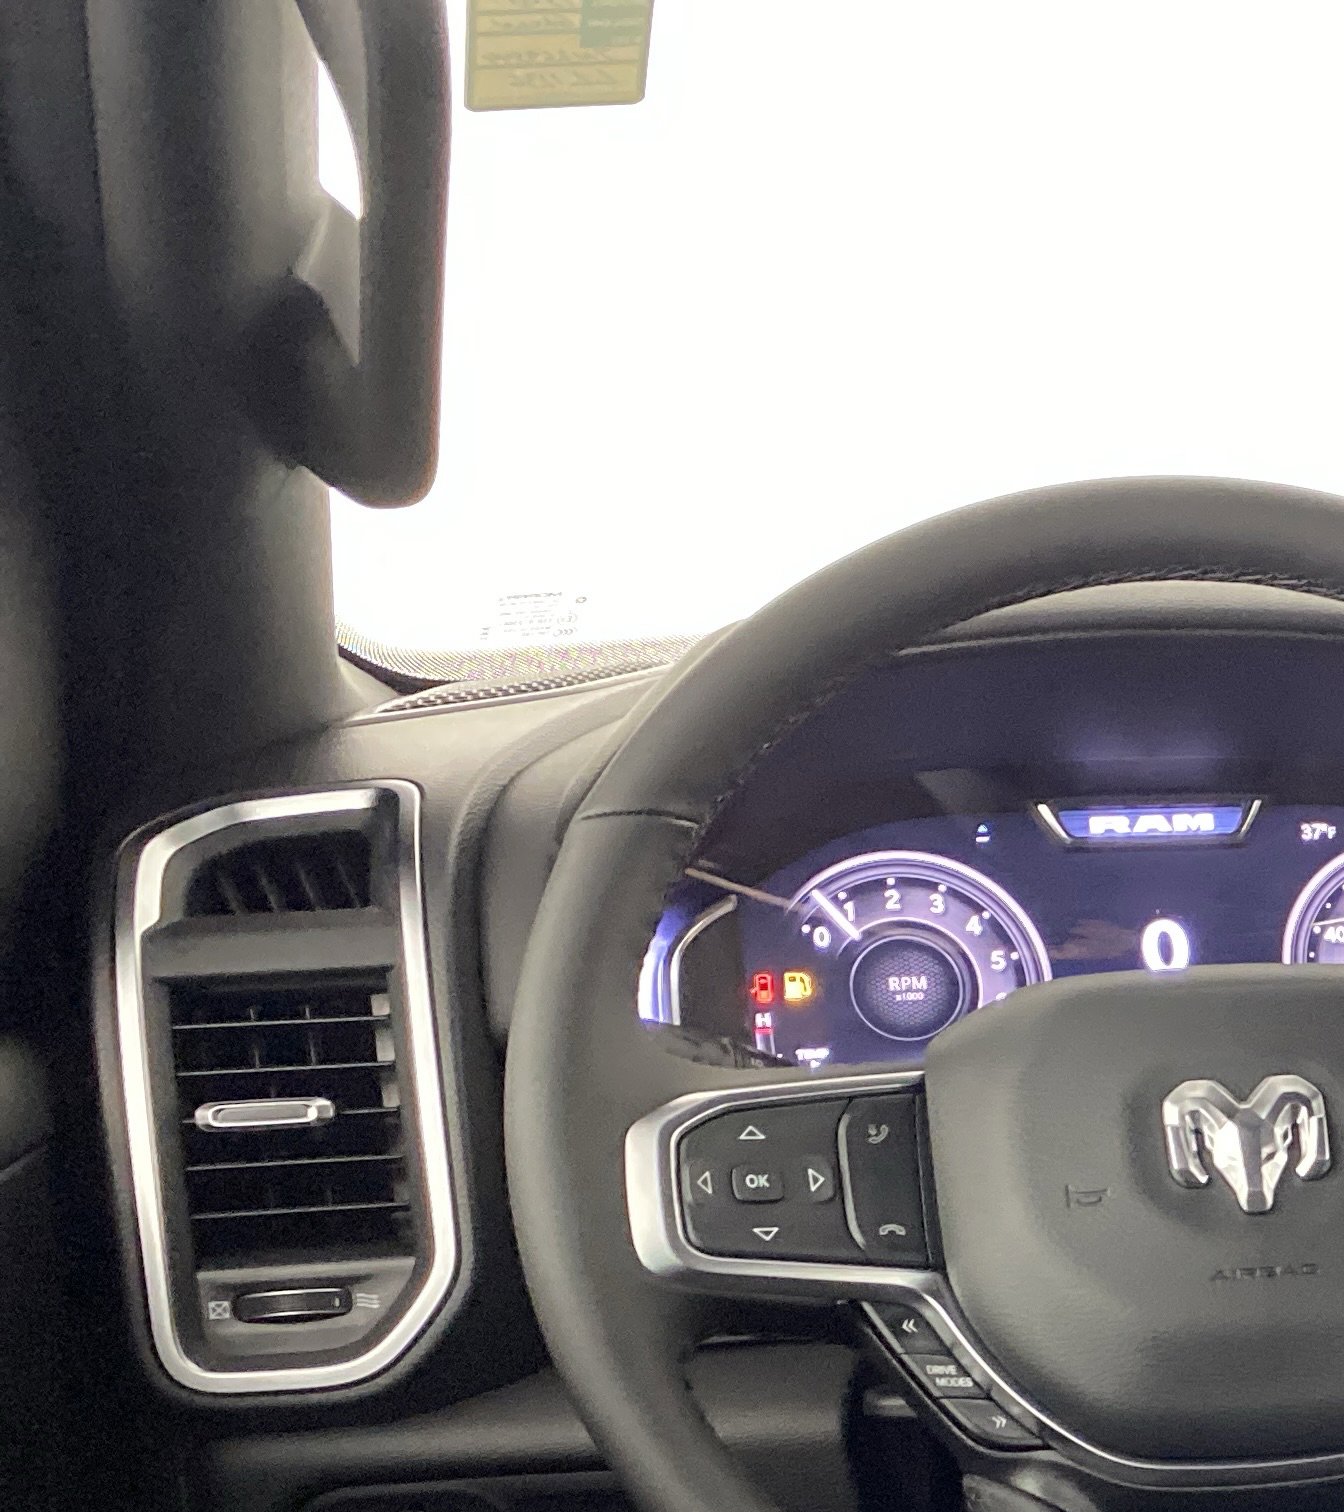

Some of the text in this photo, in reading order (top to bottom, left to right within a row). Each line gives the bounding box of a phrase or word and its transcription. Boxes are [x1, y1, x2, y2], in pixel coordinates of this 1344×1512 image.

[1088, 812, 1216, 835] RAM
[883, 888, 901, 911] 2
[929, 892, 945, 915] 3
[843, 900, 856, 923] 1
[812, 925, 832, 949] 0
[965, 914, 984, 937] 4
[1141, 918, 1191, 972] 0
[990, 949, 1008, 972] 5
[887, 975, 928, 992] RPM
[755, 1012, 772, 1027] H
[745, 1174, 770, 1189] OK
[926, 1364, 957, 1376] DRIVE
[935, 1376, 974, 1388] MODES
